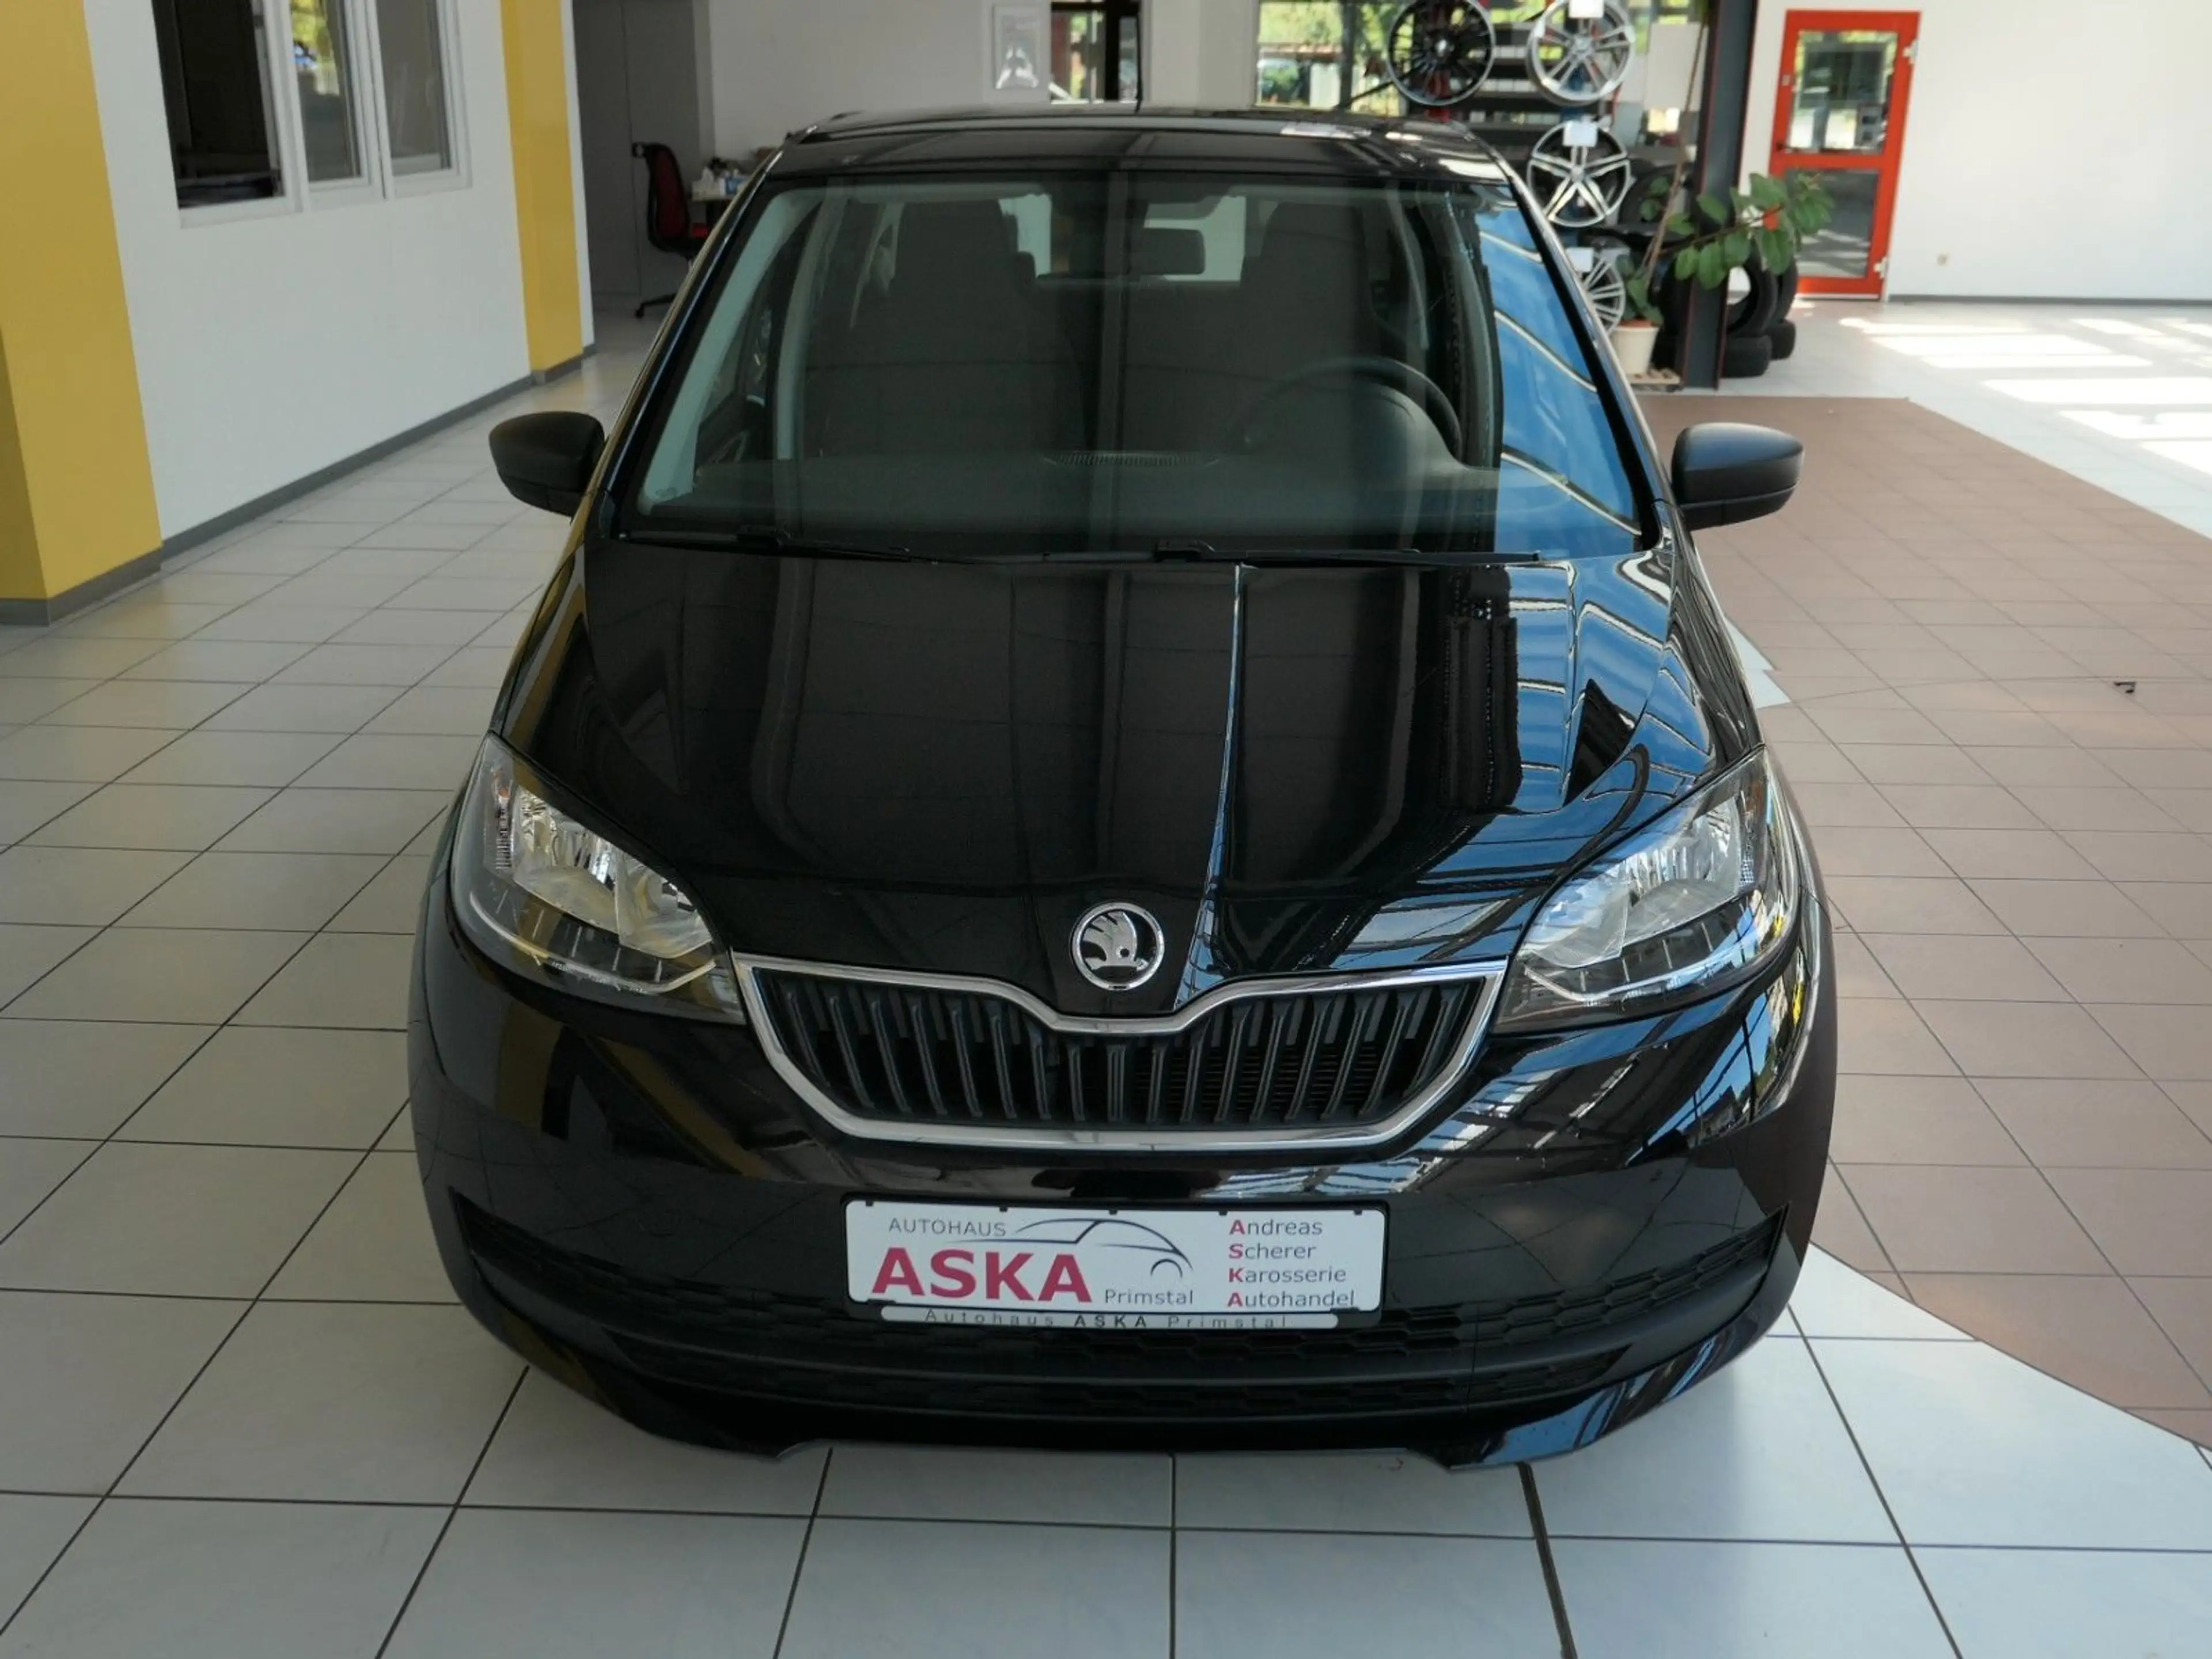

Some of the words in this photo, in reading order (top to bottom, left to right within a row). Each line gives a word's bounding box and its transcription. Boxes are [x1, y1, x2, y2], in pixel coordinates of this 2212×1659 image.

[888, 1217, 1006, 1237] AUTOHAUS
[1229, 1218, 1323, 1236] Andreas
[1228, 1242, 1316, 1260] Scherer
[872, 1246, 1092, 1303] ASKA
[1228, 1266, 1347, 1283] Karosserie
[1104, 1288, 1193, 1305] Primstal
[1228, 1289, 1355, 1308] Autohandel
[924, 1308, 1054, 1326] Autohaus
[1074, 1315, 1147, 1328] ASKA
[1168, 1315, 1286, 1329] Primstal
